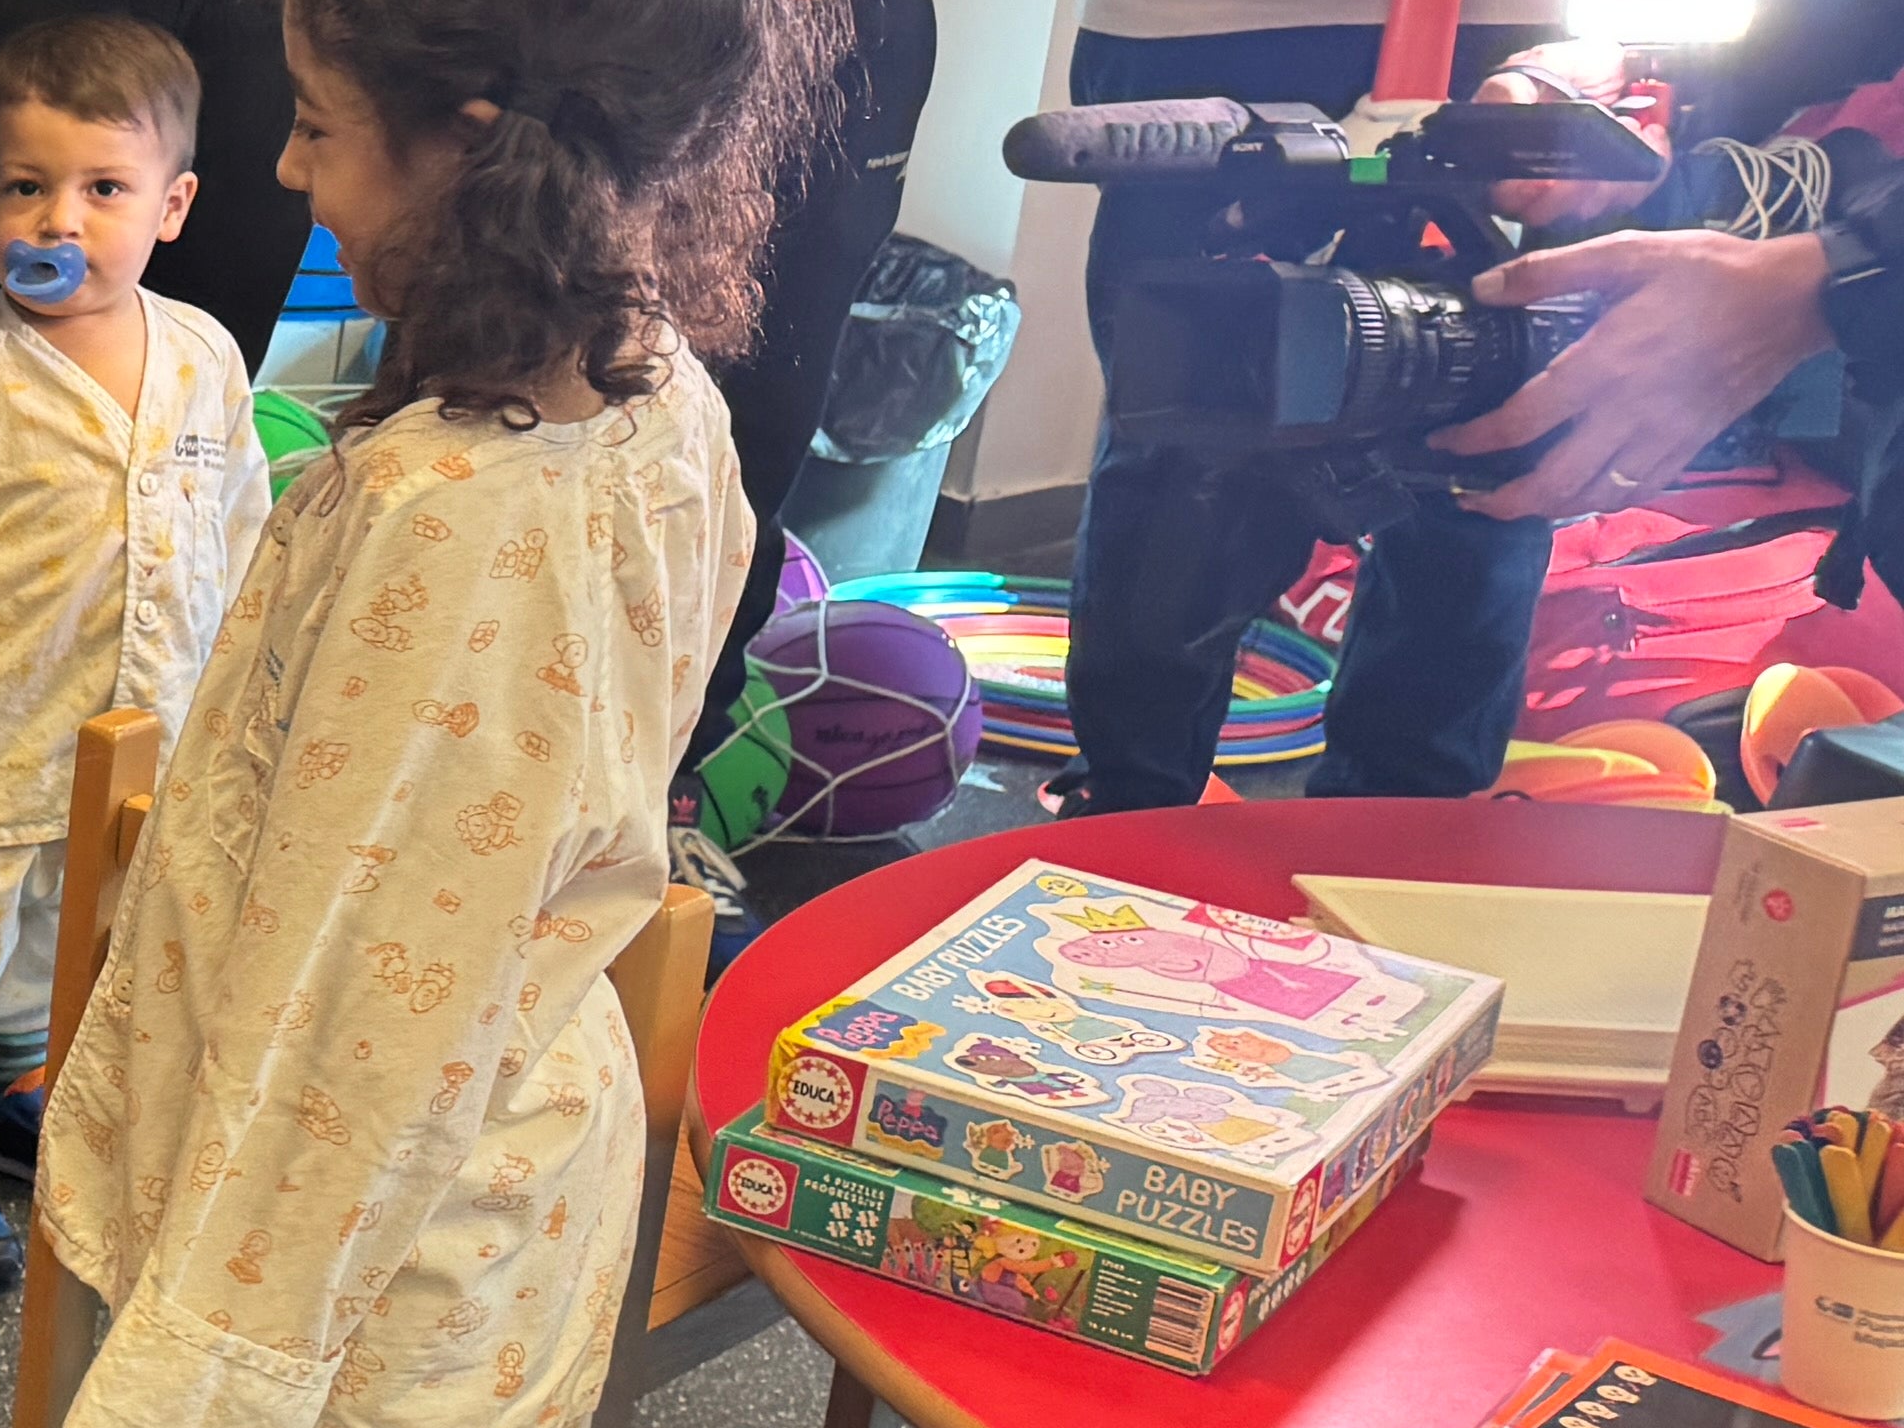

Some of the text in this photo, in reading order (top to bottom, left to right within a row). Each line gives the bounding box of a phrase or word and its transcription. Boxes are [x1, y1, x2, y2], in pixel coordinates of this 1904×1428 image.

[891, 914, 1028, 1002] BABY PUZZLES
[792, 1080, 836, 1105] EDUCA
[877, 1099, 940, 1142] Peppa
[741, 1176, 775, 1197] EDUCA
[1144, 1164, 1238, 1211] BABY
[1116, 1188, 1260, 1253] PUZZLES
